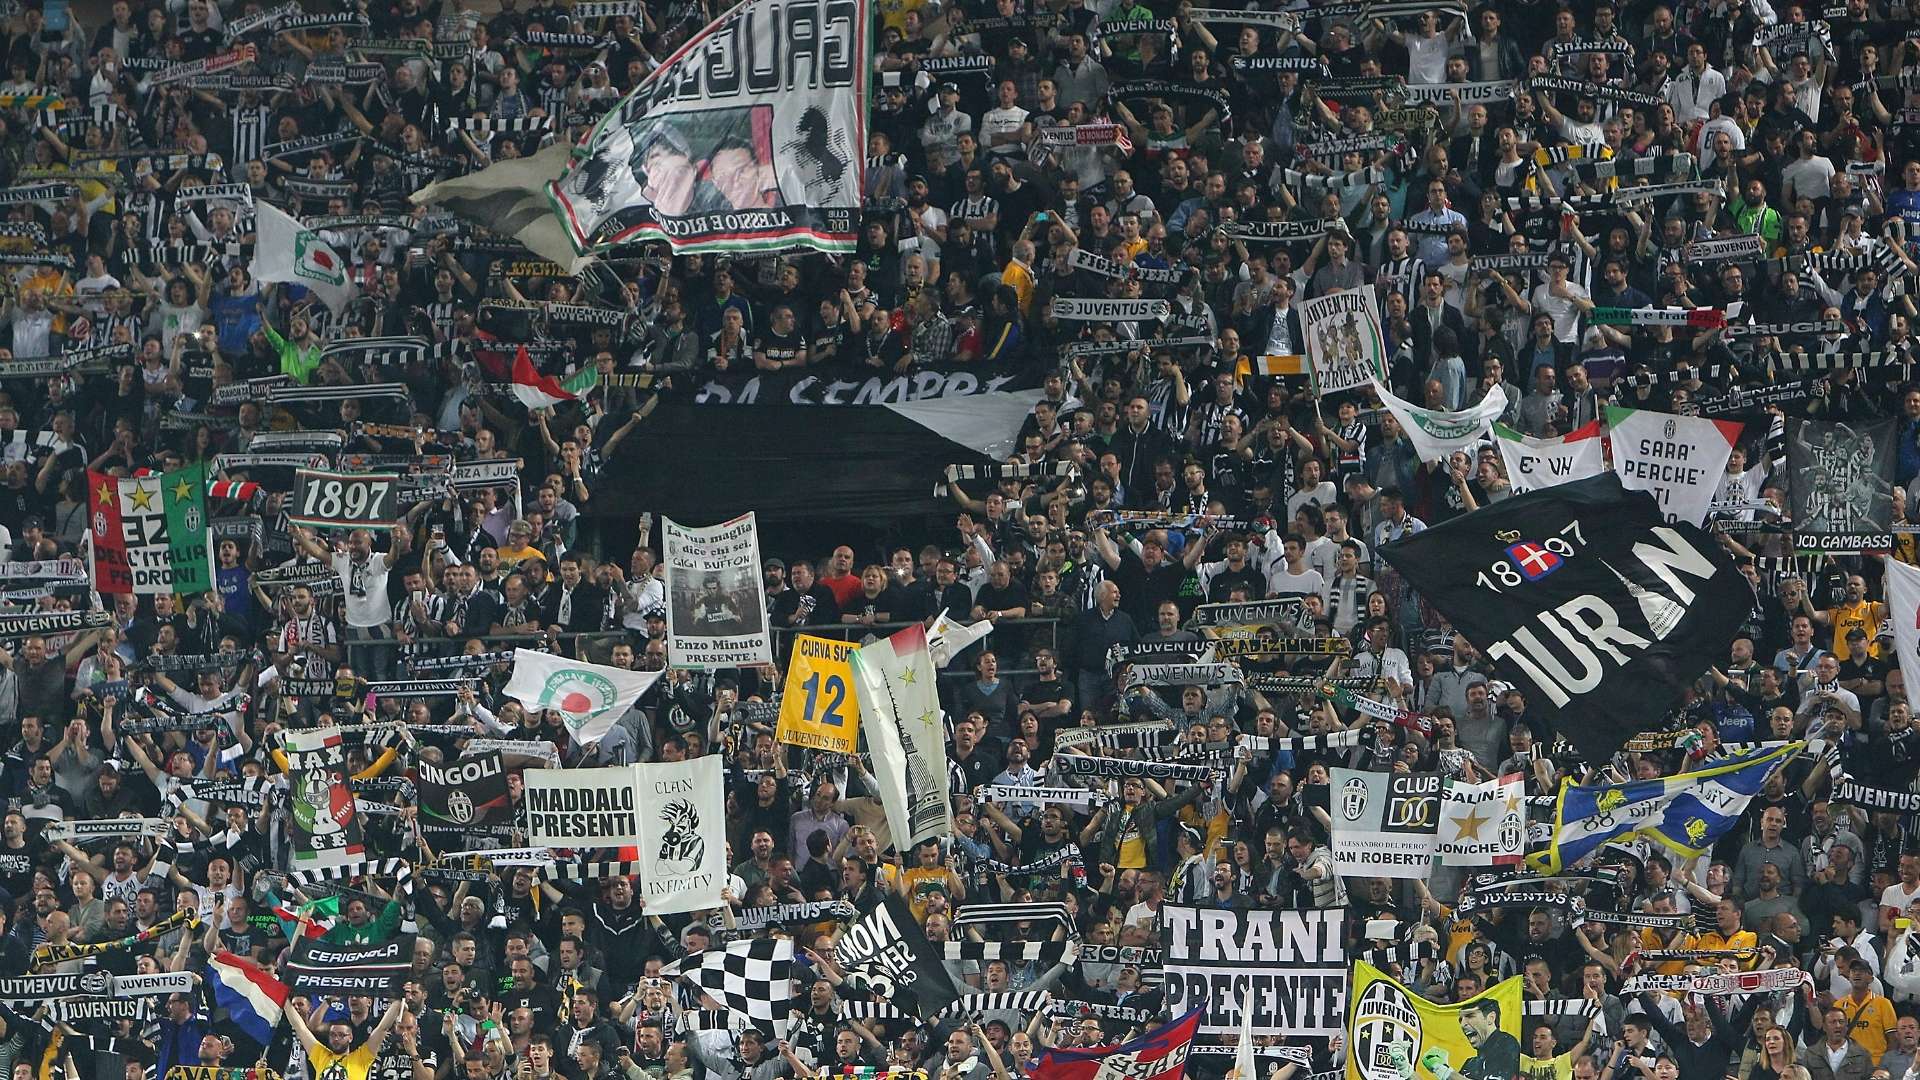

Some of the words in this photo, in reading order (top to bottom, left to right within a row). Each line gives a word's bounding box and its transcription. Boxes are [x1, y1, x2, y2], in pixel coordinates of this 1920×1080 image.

[1105, 20, 1171, 33] JUVENTUS
[527, 31, 595, 44] JUVENTUS
[123, 57, 178, 70] UVENTU
[924, 55, 989, 71] JUVENTUS
[1249, 58, 1317, 69] JUVENTUS
[1414, 85, 1492, 101] JUVENTUS
[1532, 78, 1582, 91] BRIGANTI
[1601, 87, 1662, 104] BIANCONE
[239, 115, 259, 124] Jeep
[1041, 131, 1074, 141] VENTUS
[180, 185, 248, 200] JUVENTU
[1713, 240, 1759, 255] JUVENTUS
[506, 261, 569, 276] JUVENT
[1472, 254, 1550, 269] JUVENTUS
[552, 305, 619, 325] JUVENTUS
[1076, 301, 1148, 316] JUVENTUS
[1304, 293, 1366, 326] JUVENTUS
[1727, 322, 1838, 337] DRUGHI
[1706, 399, 1755, 413] CLUB
[1756, 389, 1806, 404] TREIA
[1639, 439, 1696, 461] SARA'
[452, 466, 481, 480] RZA
[1624, 461, 1705, 486] PERCHE'
[304, 479, 390, 520] 1897
[1654, 488, 1670, 505] TI
[214, 523, 248, 535] VED
[667, 525, 682, 538] La
[684, 533, 706, 545] tua
[710, 524, 753, 544] maglia
[682, 544, 707, 556] dice
[711, 546, 730, 557] chi
[732, 541, 753, 552] sei.
[1796, 534, 1818, 548] JCD
[1821, 534, 1893, 549] GAMBASSI
[96, 545, 207, 567] DELL'ITALIA
[672, 558, 698, 569] GIGI
[703, 554, 750, 570] BUFFON
[1477, 560, 1522, 594] 18
[1543, 520, 1588, 557] 97
[110, 566, 197, 585] PADRONI
[218, 585, 238, 595] eep
[1211, 602, 1300, 624] JUVENTUS
[0, 613, 82, 634] JUVENTUS
[1840, 618, 1865, 630] Jeep
[675, 639, 710, 651] Enzo
[713, 637, 763, 650] Minuto
[800, 640, 832, 660] CURVA
[1134, 640, 1215, 656] JUVENTUS
[1221, 637, 1326, 656] RADIZIONE
[686, 653, 750, 664] PRESENTE
[1141, 664, 1227, 685] JUVENTUS
[371, 684, 401, 694] ORZA
[801, 671, 846, 728] 12
[1720, 716, 1748, 727] Jeep
[783, 730, 829, 750] JUVENTUS
[830, 737, 850, 751] 1897
[418, 754, 502, 786] CINGOLI
[1080, 757, 1211, 783] DRUGHI
[353, 776, 405, 787] NTUS
[655, 779, 693, 794] CLAN
[1393, 776, 1439, 794] CLUB
[529, 787, 632, 812] MADDALO
[998, 788, 1083, 800] JUVENTUS
[1443, 787, 1504, 806] SALINE
[1837, 785, 1920, 812] JUVENTUS
[1389, 796, 1438, 828] DOC
[75, 822, 141, 834] JUVENTUS
[1386, 842, 1400, 851] DEL
[1434, 842, 1500, 857] JONICHE
[490, 850, 532, 862] ENTUS
[1335, 850, 1357, 864] SAN
[1361, 852, 1431, 866] ROBERTO
[1480, 893, 1567, 906] JUVENTUS
[741, 901, 821, 926] JUVENTUS
[1589, 910, 1619, 922] FORZA
[1627, 914, 1674, 927] JUVENTUS
[1163, 908, 1345, 963] TRANI
[307, 942, 399, 963] CERIGNOLA
[0, 978, 77, 995] JUVENTU
[120, 976, 187, 989] JUVENTUS
[295, 974, 390, 989] PRESENTE
[68, 1000, 137, 1018] JUVENTUS
[1165, 974, 1345, 1029] PRESENTE
[1360, 1001, 1417, 1028] JUVENTUS
